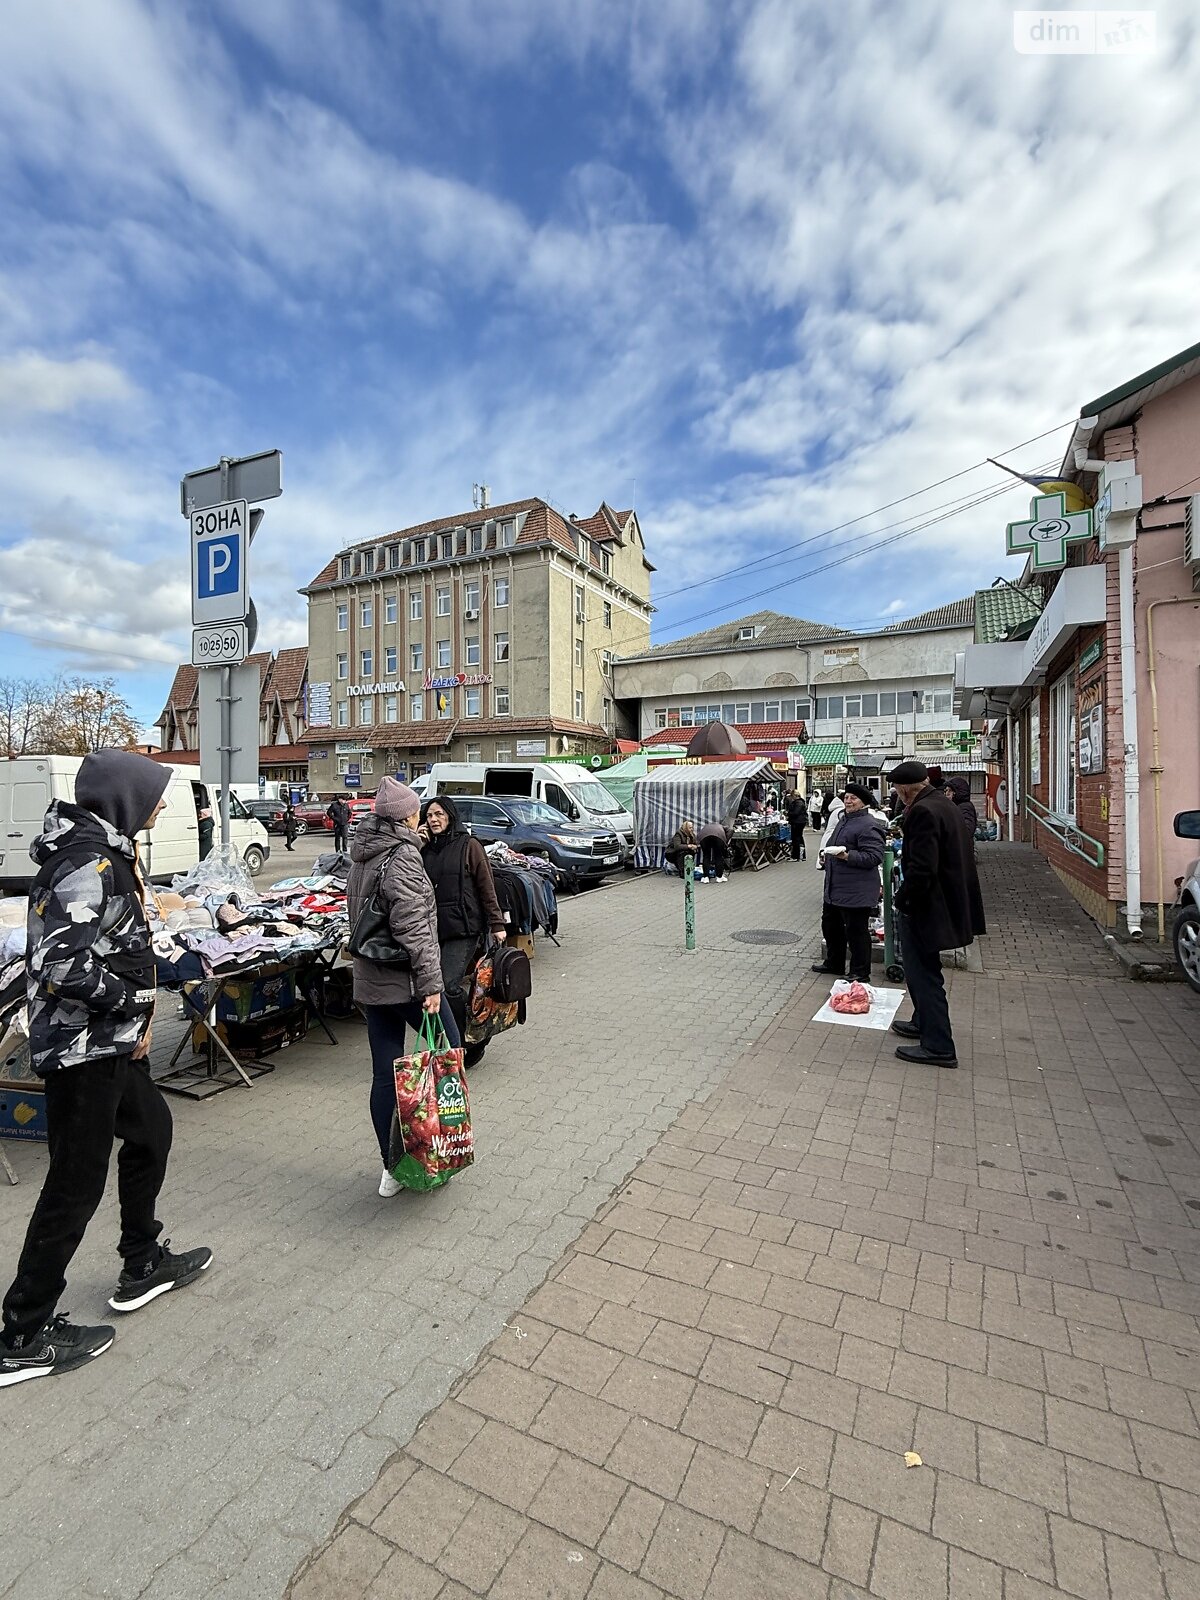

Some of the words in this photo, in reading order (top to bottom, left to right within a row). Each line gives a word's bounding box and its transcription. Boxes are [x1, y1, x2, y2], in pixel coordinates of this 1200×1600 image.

[195, 507, 242, 537] ЗОНА
[208, 543, 232, 592] P
[200, 641, 208, 652] 10
[210, 639, 221, 651] 25
[223, 636, 236, 650] 50
[346, 681, 406, 697] ПОЛІКЛІНІКА
